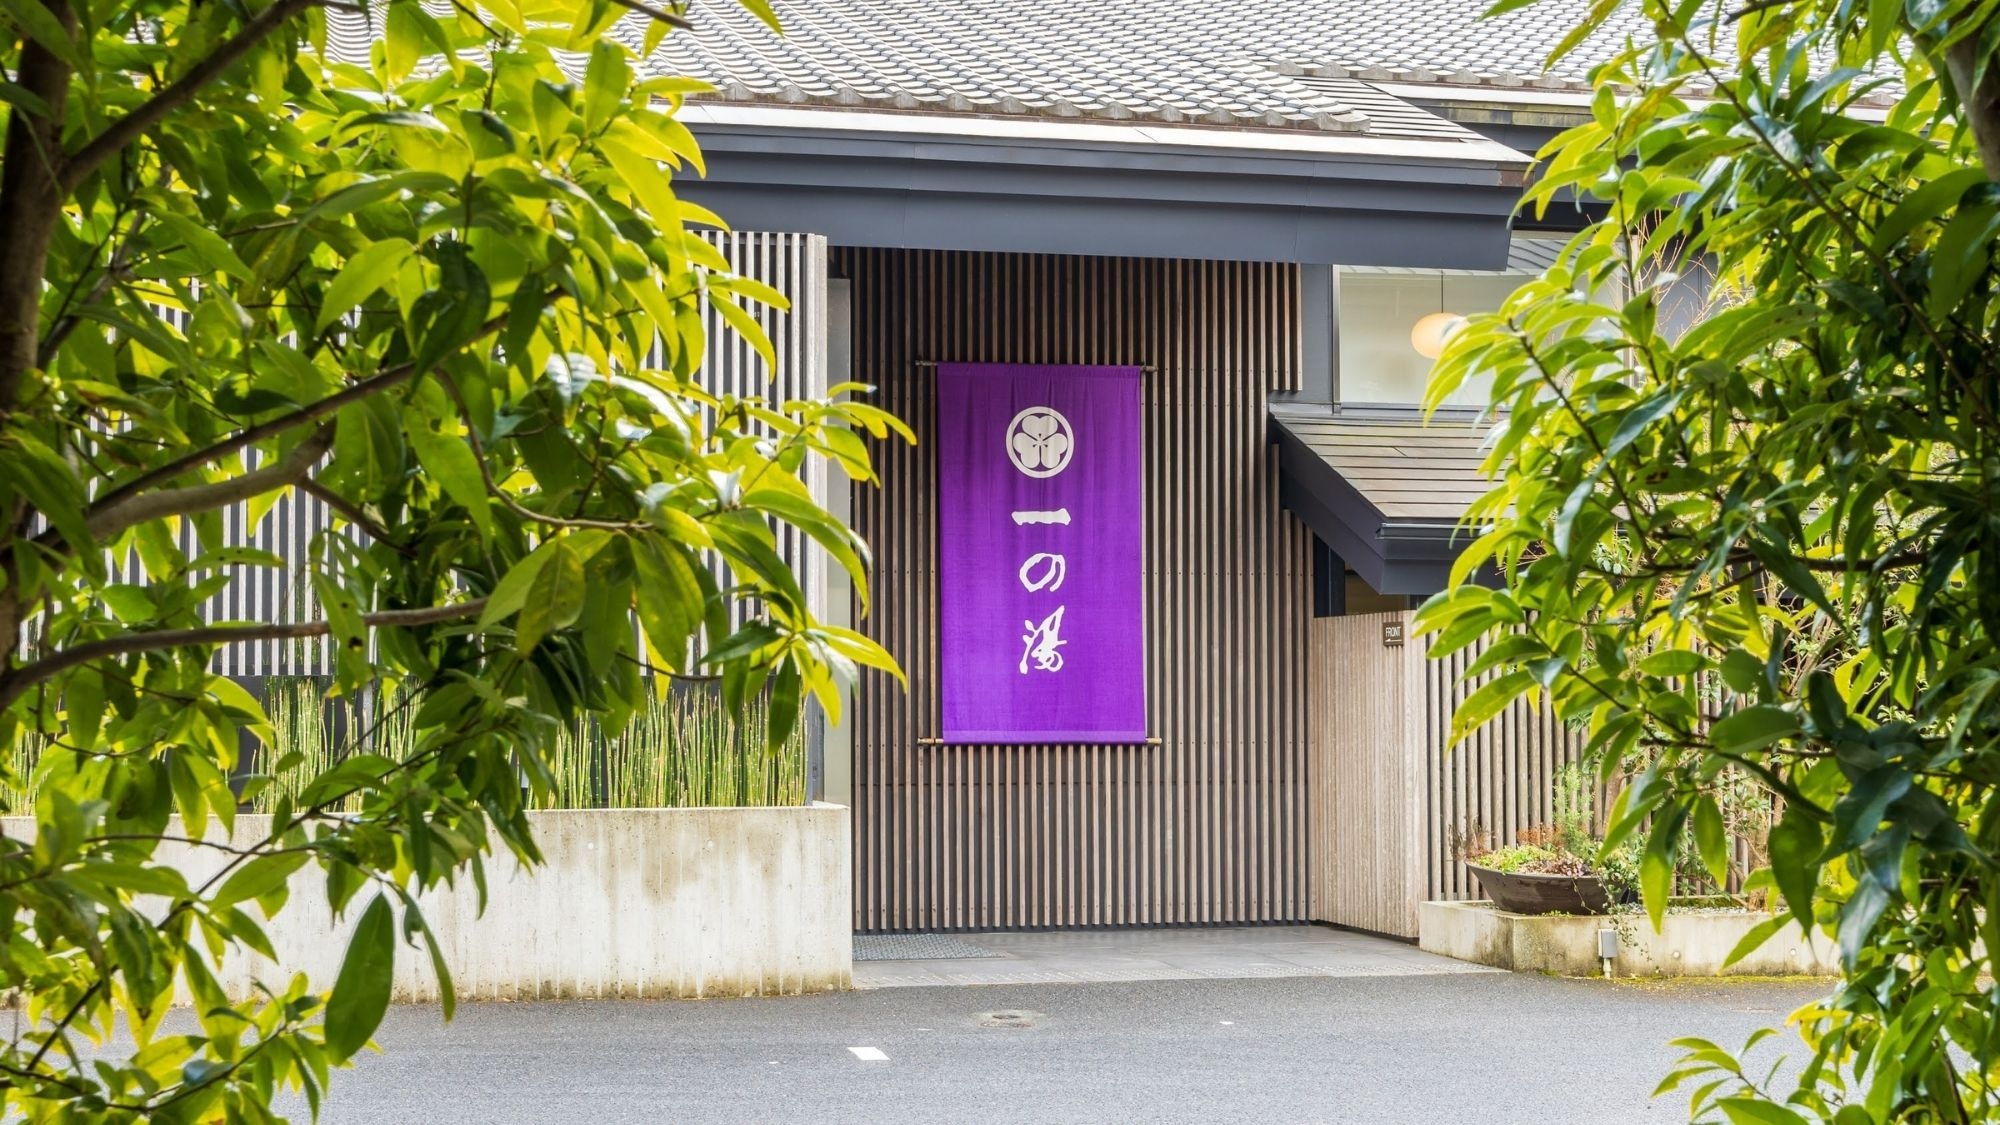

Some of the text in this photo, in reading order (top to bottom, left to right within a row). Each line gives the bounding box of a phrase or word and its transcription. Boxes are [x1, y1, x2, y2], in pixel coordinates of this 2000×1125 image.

[1011, 508, 1072, 675] 一の湯
[1385, 626, 1401, 637] FRONT
